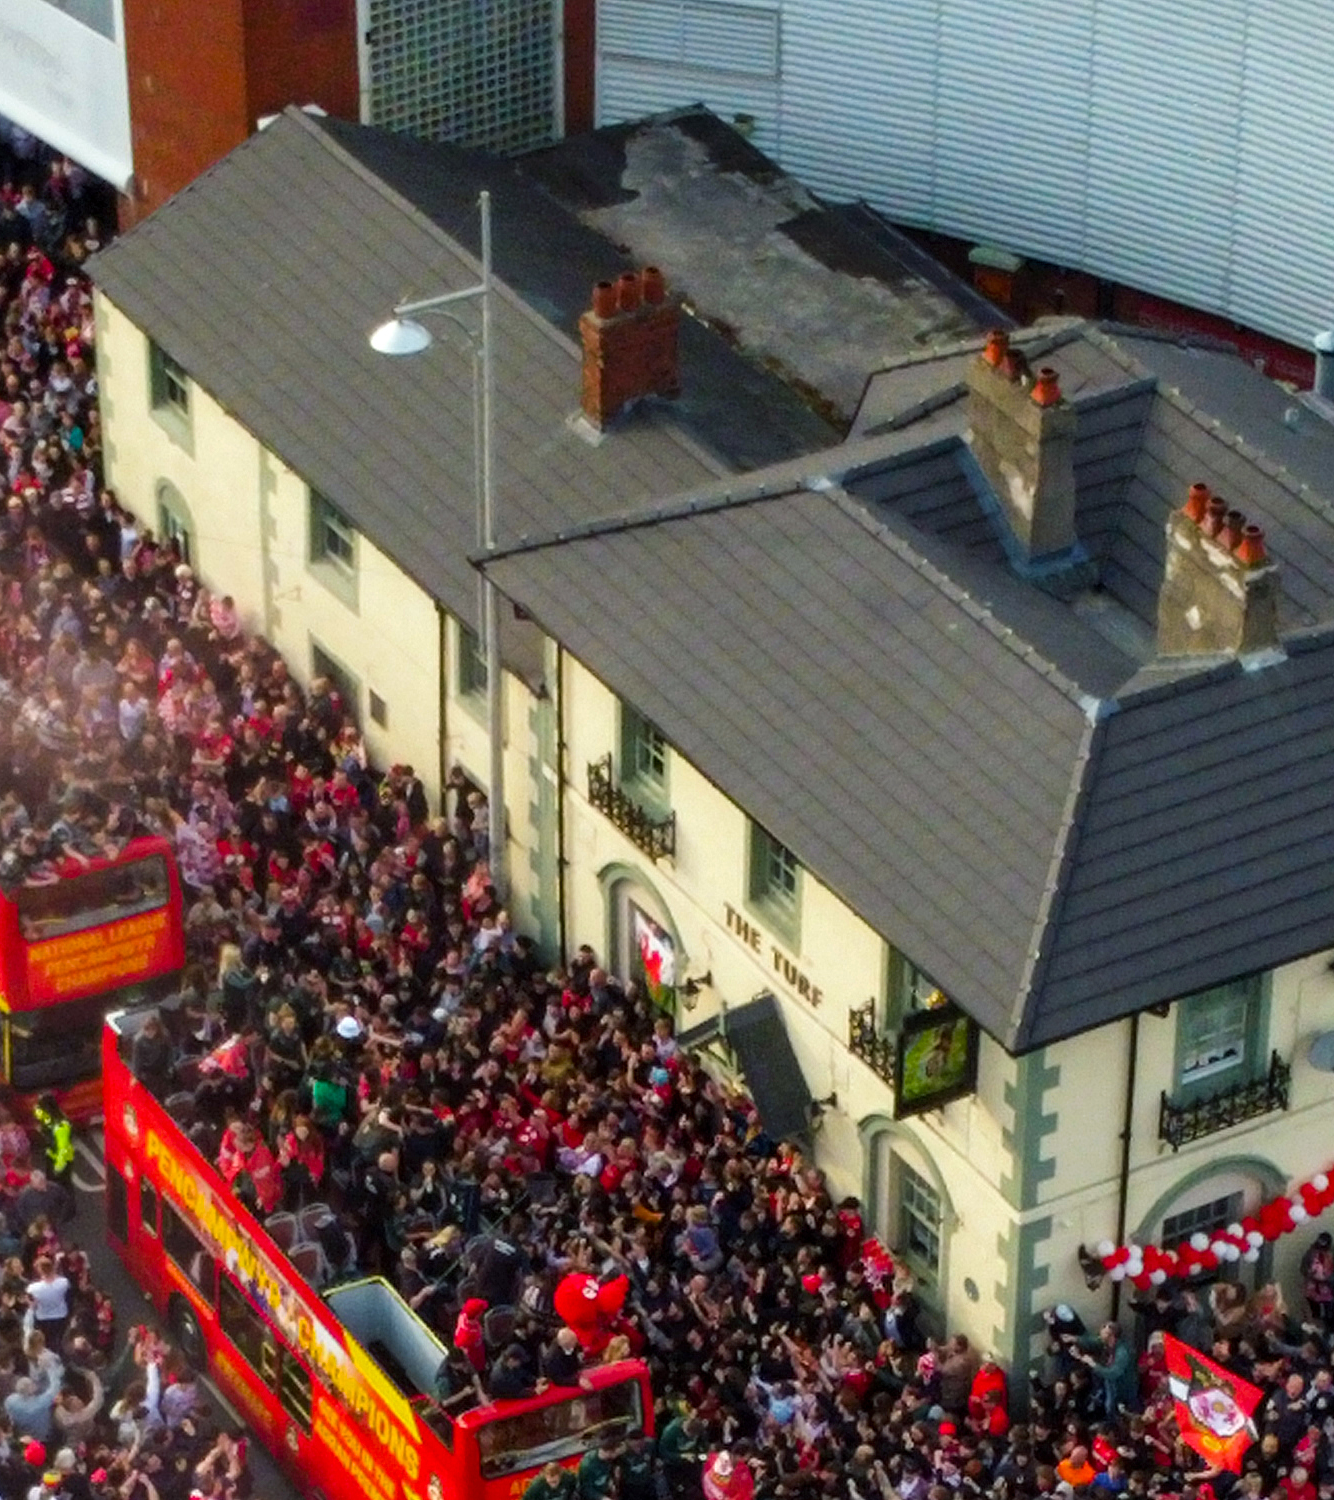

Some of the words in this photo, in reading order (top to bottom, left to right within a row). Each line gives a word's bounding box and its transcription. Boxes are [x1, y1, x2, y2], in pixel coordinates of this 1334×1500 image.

[723, 900, 761, 954] THE
[771, 946, 823, 1009] TURF
[298, 1315, 419, 1480] CHAMPIONS
